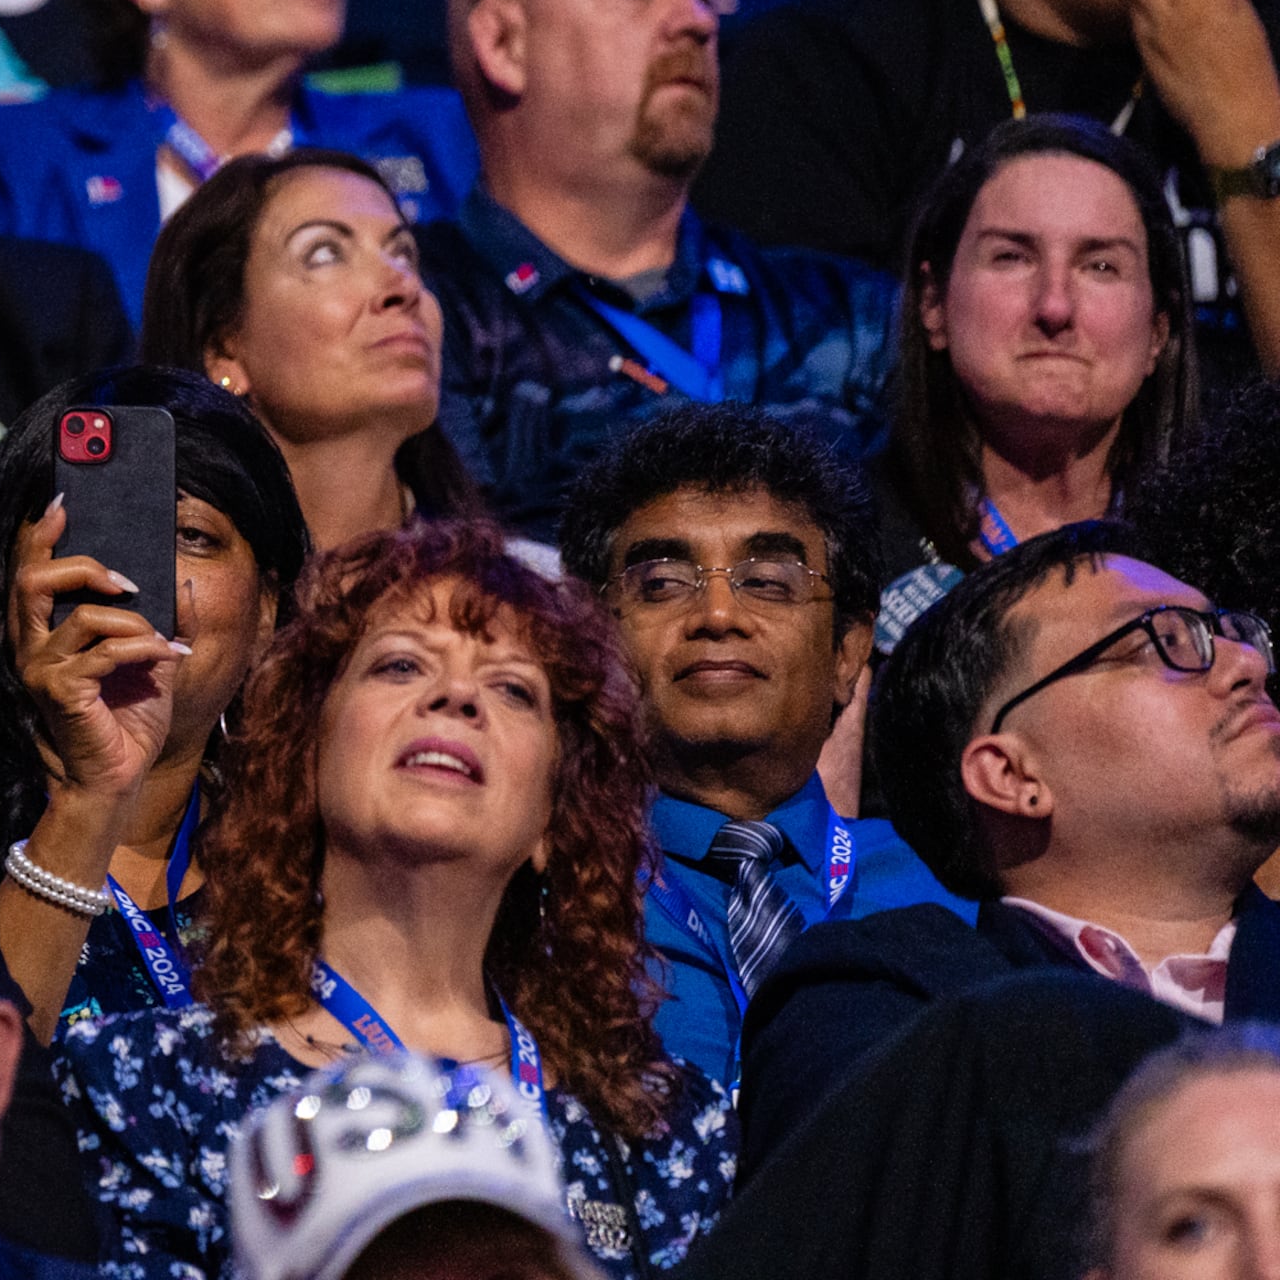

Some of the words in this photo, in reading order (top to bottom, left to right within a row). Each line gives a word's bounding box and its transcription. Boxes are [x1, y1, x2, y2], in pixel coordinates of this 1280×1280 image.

[831, 825, 853, 865] 2024
[113, 888, 153, 933] DNC
[144, 947, 187, 997] 2024
